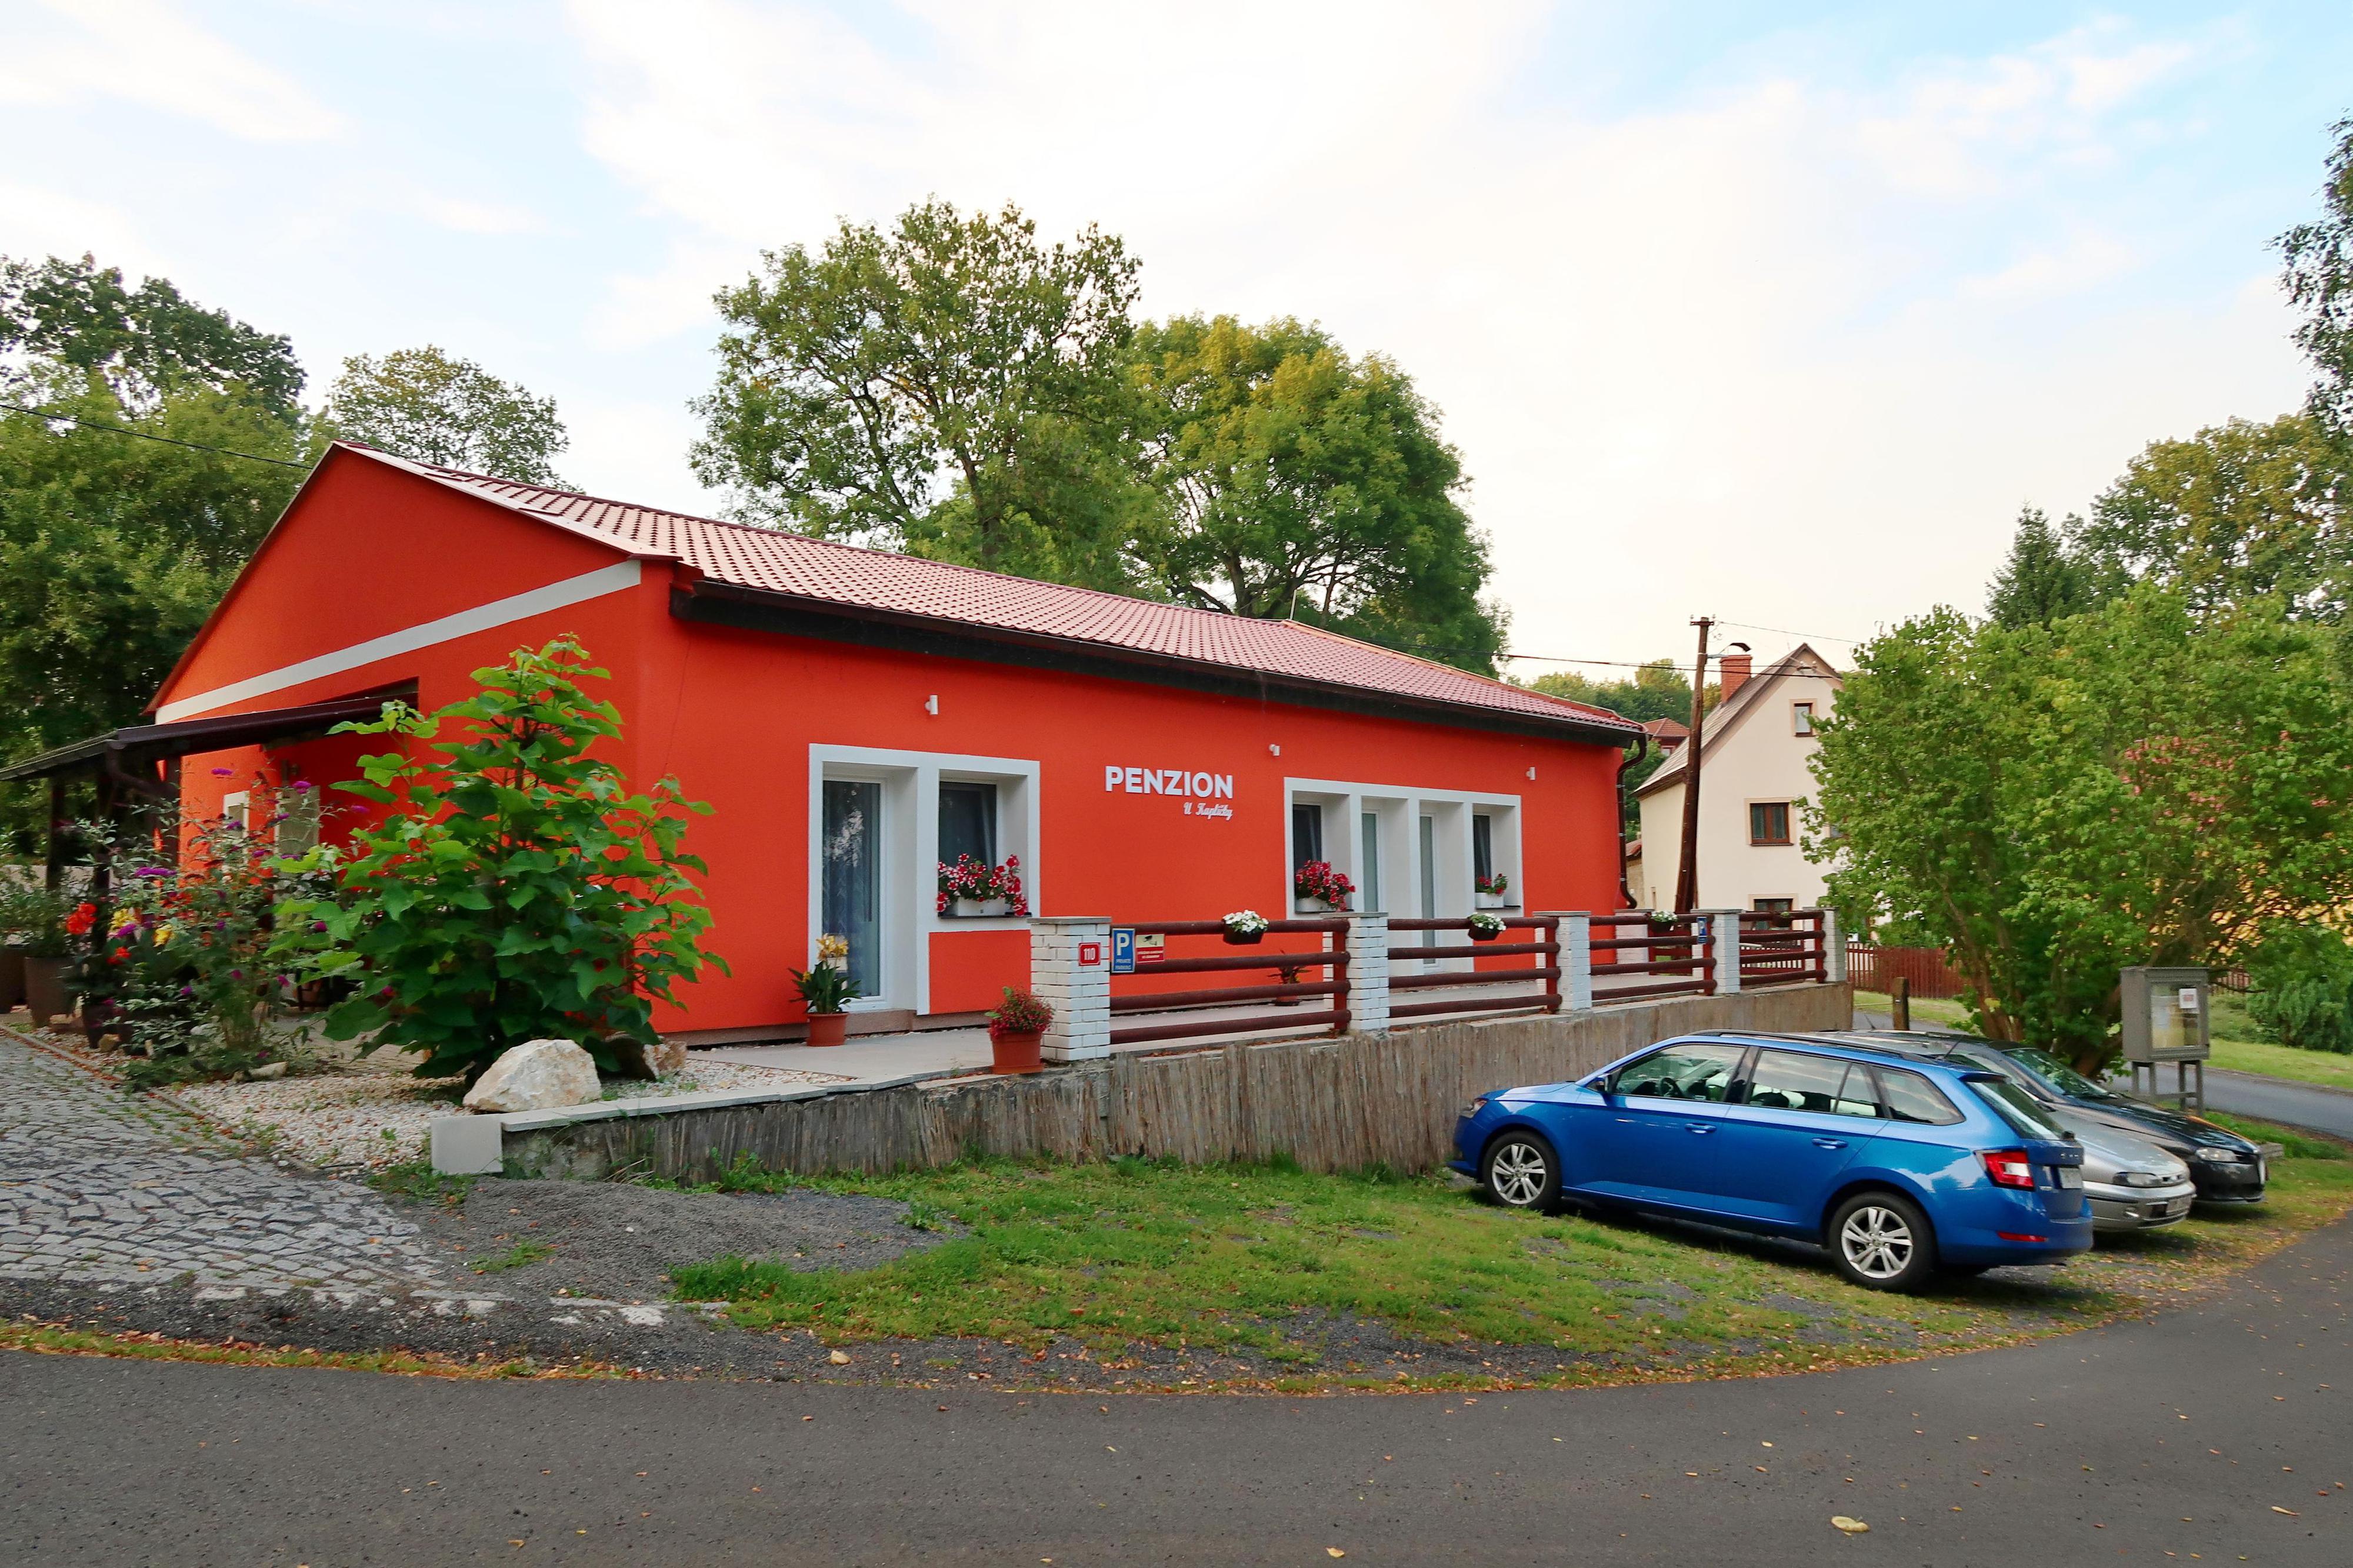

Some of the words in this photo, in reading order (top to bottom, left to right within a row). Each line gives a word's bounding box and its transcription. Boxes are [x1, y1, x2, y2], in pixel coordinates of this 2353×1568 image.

[1105, 765, 1234, 799] PENZION
[1184, 802, 1192, 815] U
[1116, 933, 1130, 956] P
[1083, 948, 1096, 960] 110
